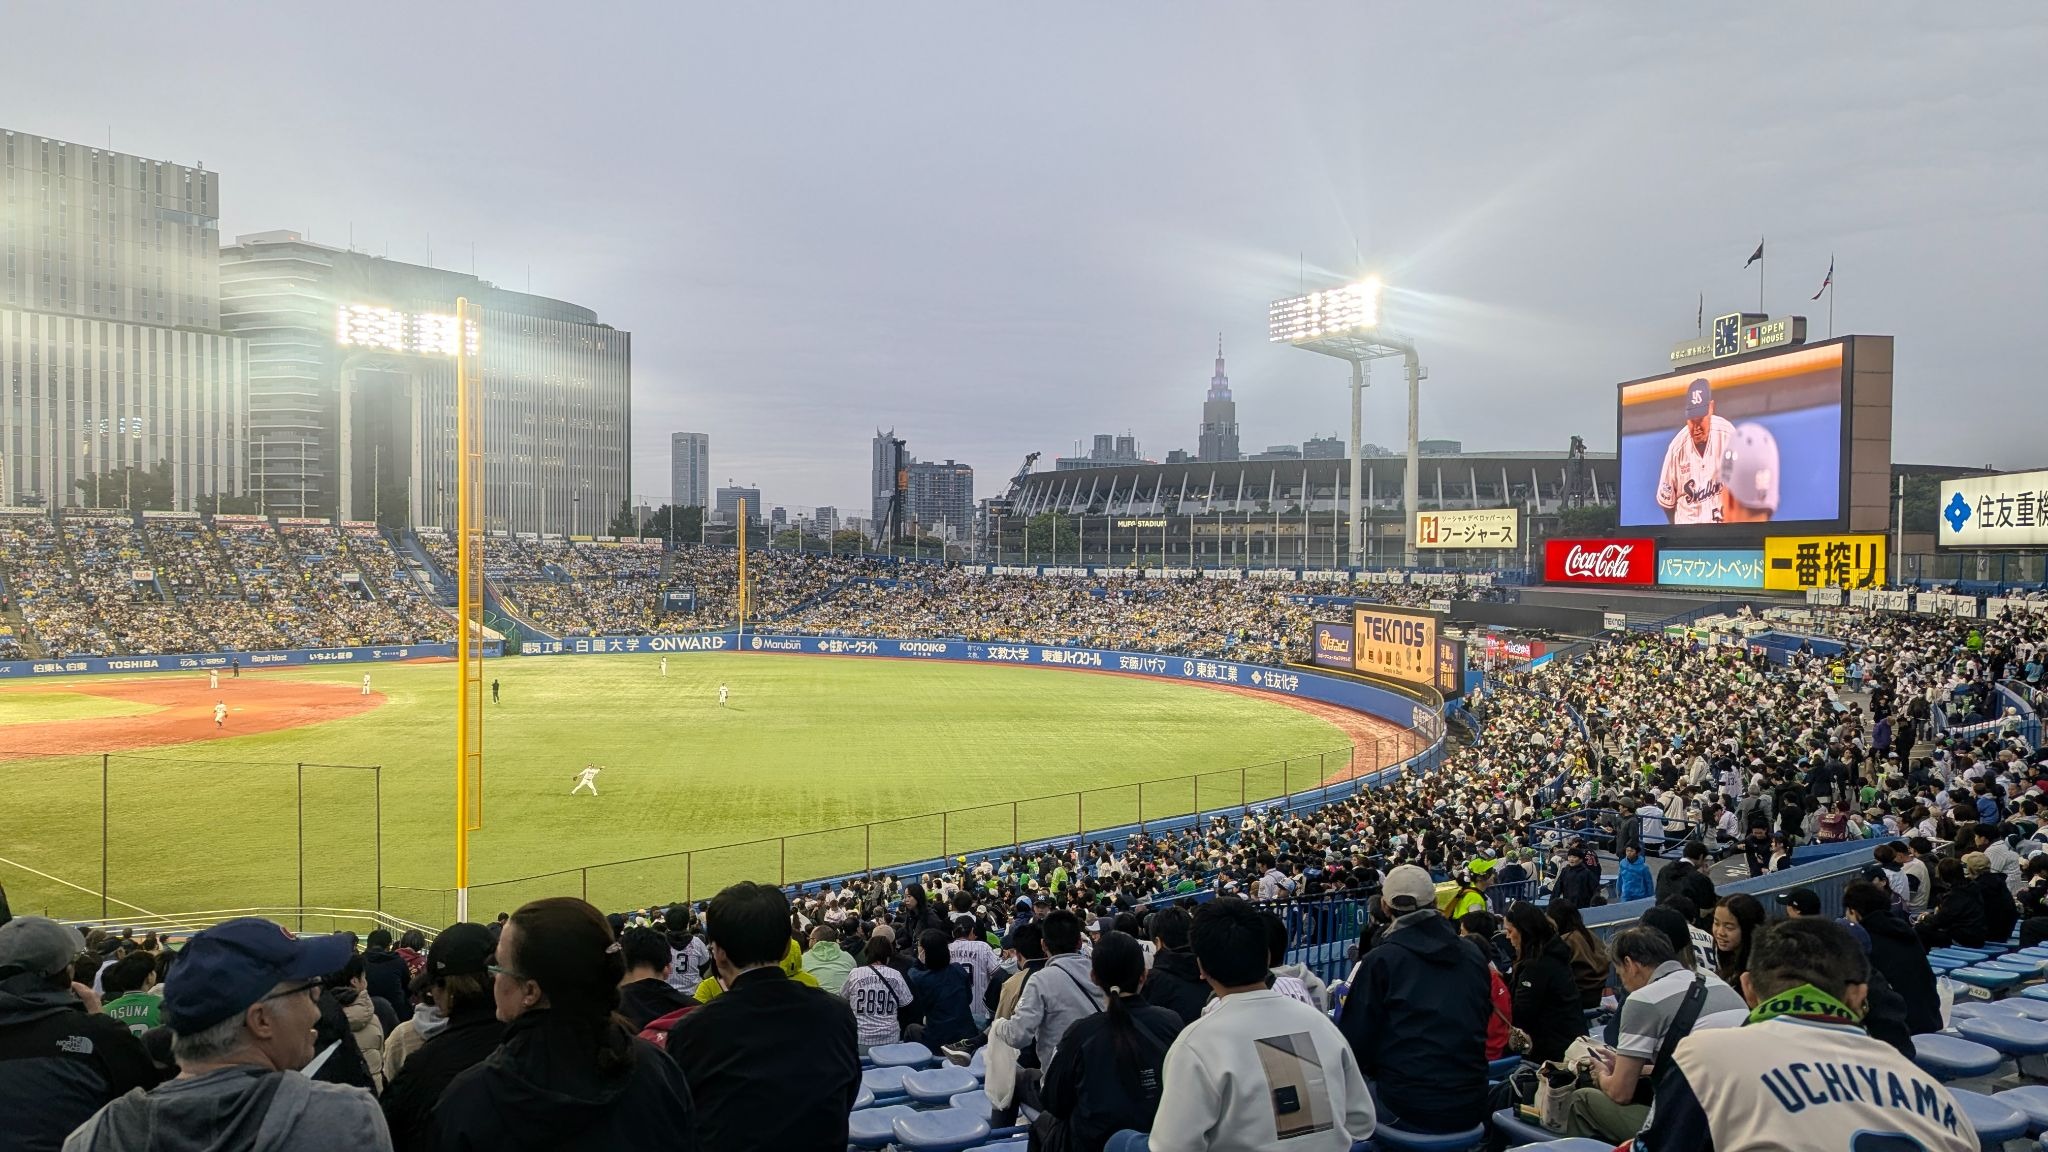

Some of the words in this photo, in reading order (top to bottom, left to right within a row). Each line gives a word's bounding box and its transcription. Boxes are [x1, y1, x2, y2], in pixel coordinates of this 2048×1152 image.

[1761, 322, 1784, 335] OPEN
[1761, 332, 1784, 345] HOUSE
[1138, 520, 1167, 528] STADIUM
[1441, 524, 1513, 543] フージャース
[1565, 544, 1634, 578] Coca-Cola
[1660, 557, 1764, 581] パラマウントベッド
[1771, 541, 1877, 588] 一番搾り
[1605, 617, 1625, 627] TEKNOS
[1364, 616, 1425, 647] TEKNOS
[649, 637, 726, 651] ONWARD
[763, 640, 802, 650] Marubun
[251, 655, 271, 664] Royal
[271, 654, 287, 662] Host
[987, 647, 1029, 661] 文教大学
[1041, 649, 1102, 666] 東進ハイスクール
[107, 660, 159, 669] TOSHIBA
[1119, 655, 1166, 673] 安藤ハザマ
[1196, 662, 1238, 682] 東鉄工業
[1263, 671, 1299, 691] 住友化学
[675, 952, 689, 974] 3
[856, 988, 894, 1015] 2896
[1760, 1062, 1958, 1137] UCHIYAMA
